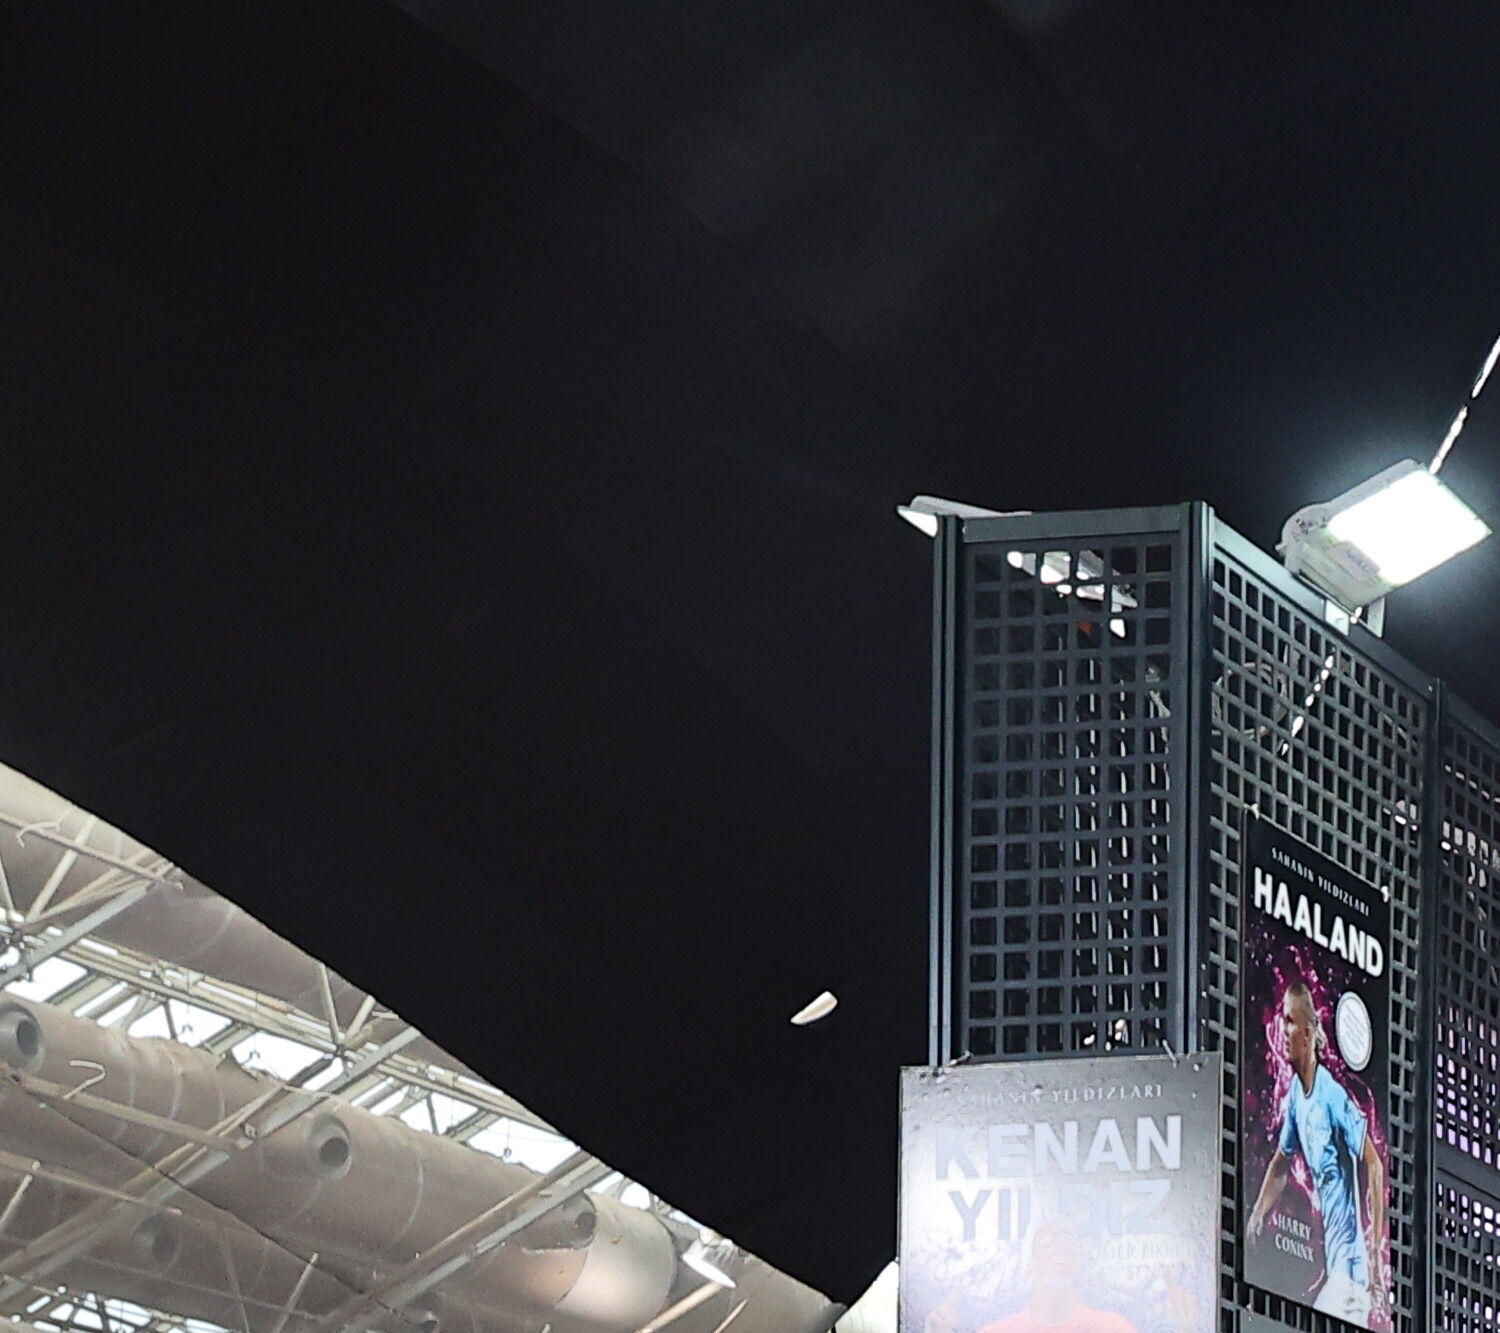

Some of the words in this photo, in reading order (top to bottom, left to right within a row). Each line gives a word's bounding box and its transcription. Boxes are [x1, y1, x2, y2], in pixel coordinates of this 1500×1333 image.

[1253, 866, 1384, 978] HAALAND
[1052, 1083, 1163, 1103] YILDIZLARI
[935, 1114, 1182, 1181] KENAN
[1277, 1212, 1312, 1241] HARRY
[1275, 1233, 1315, 1263] CONINX
